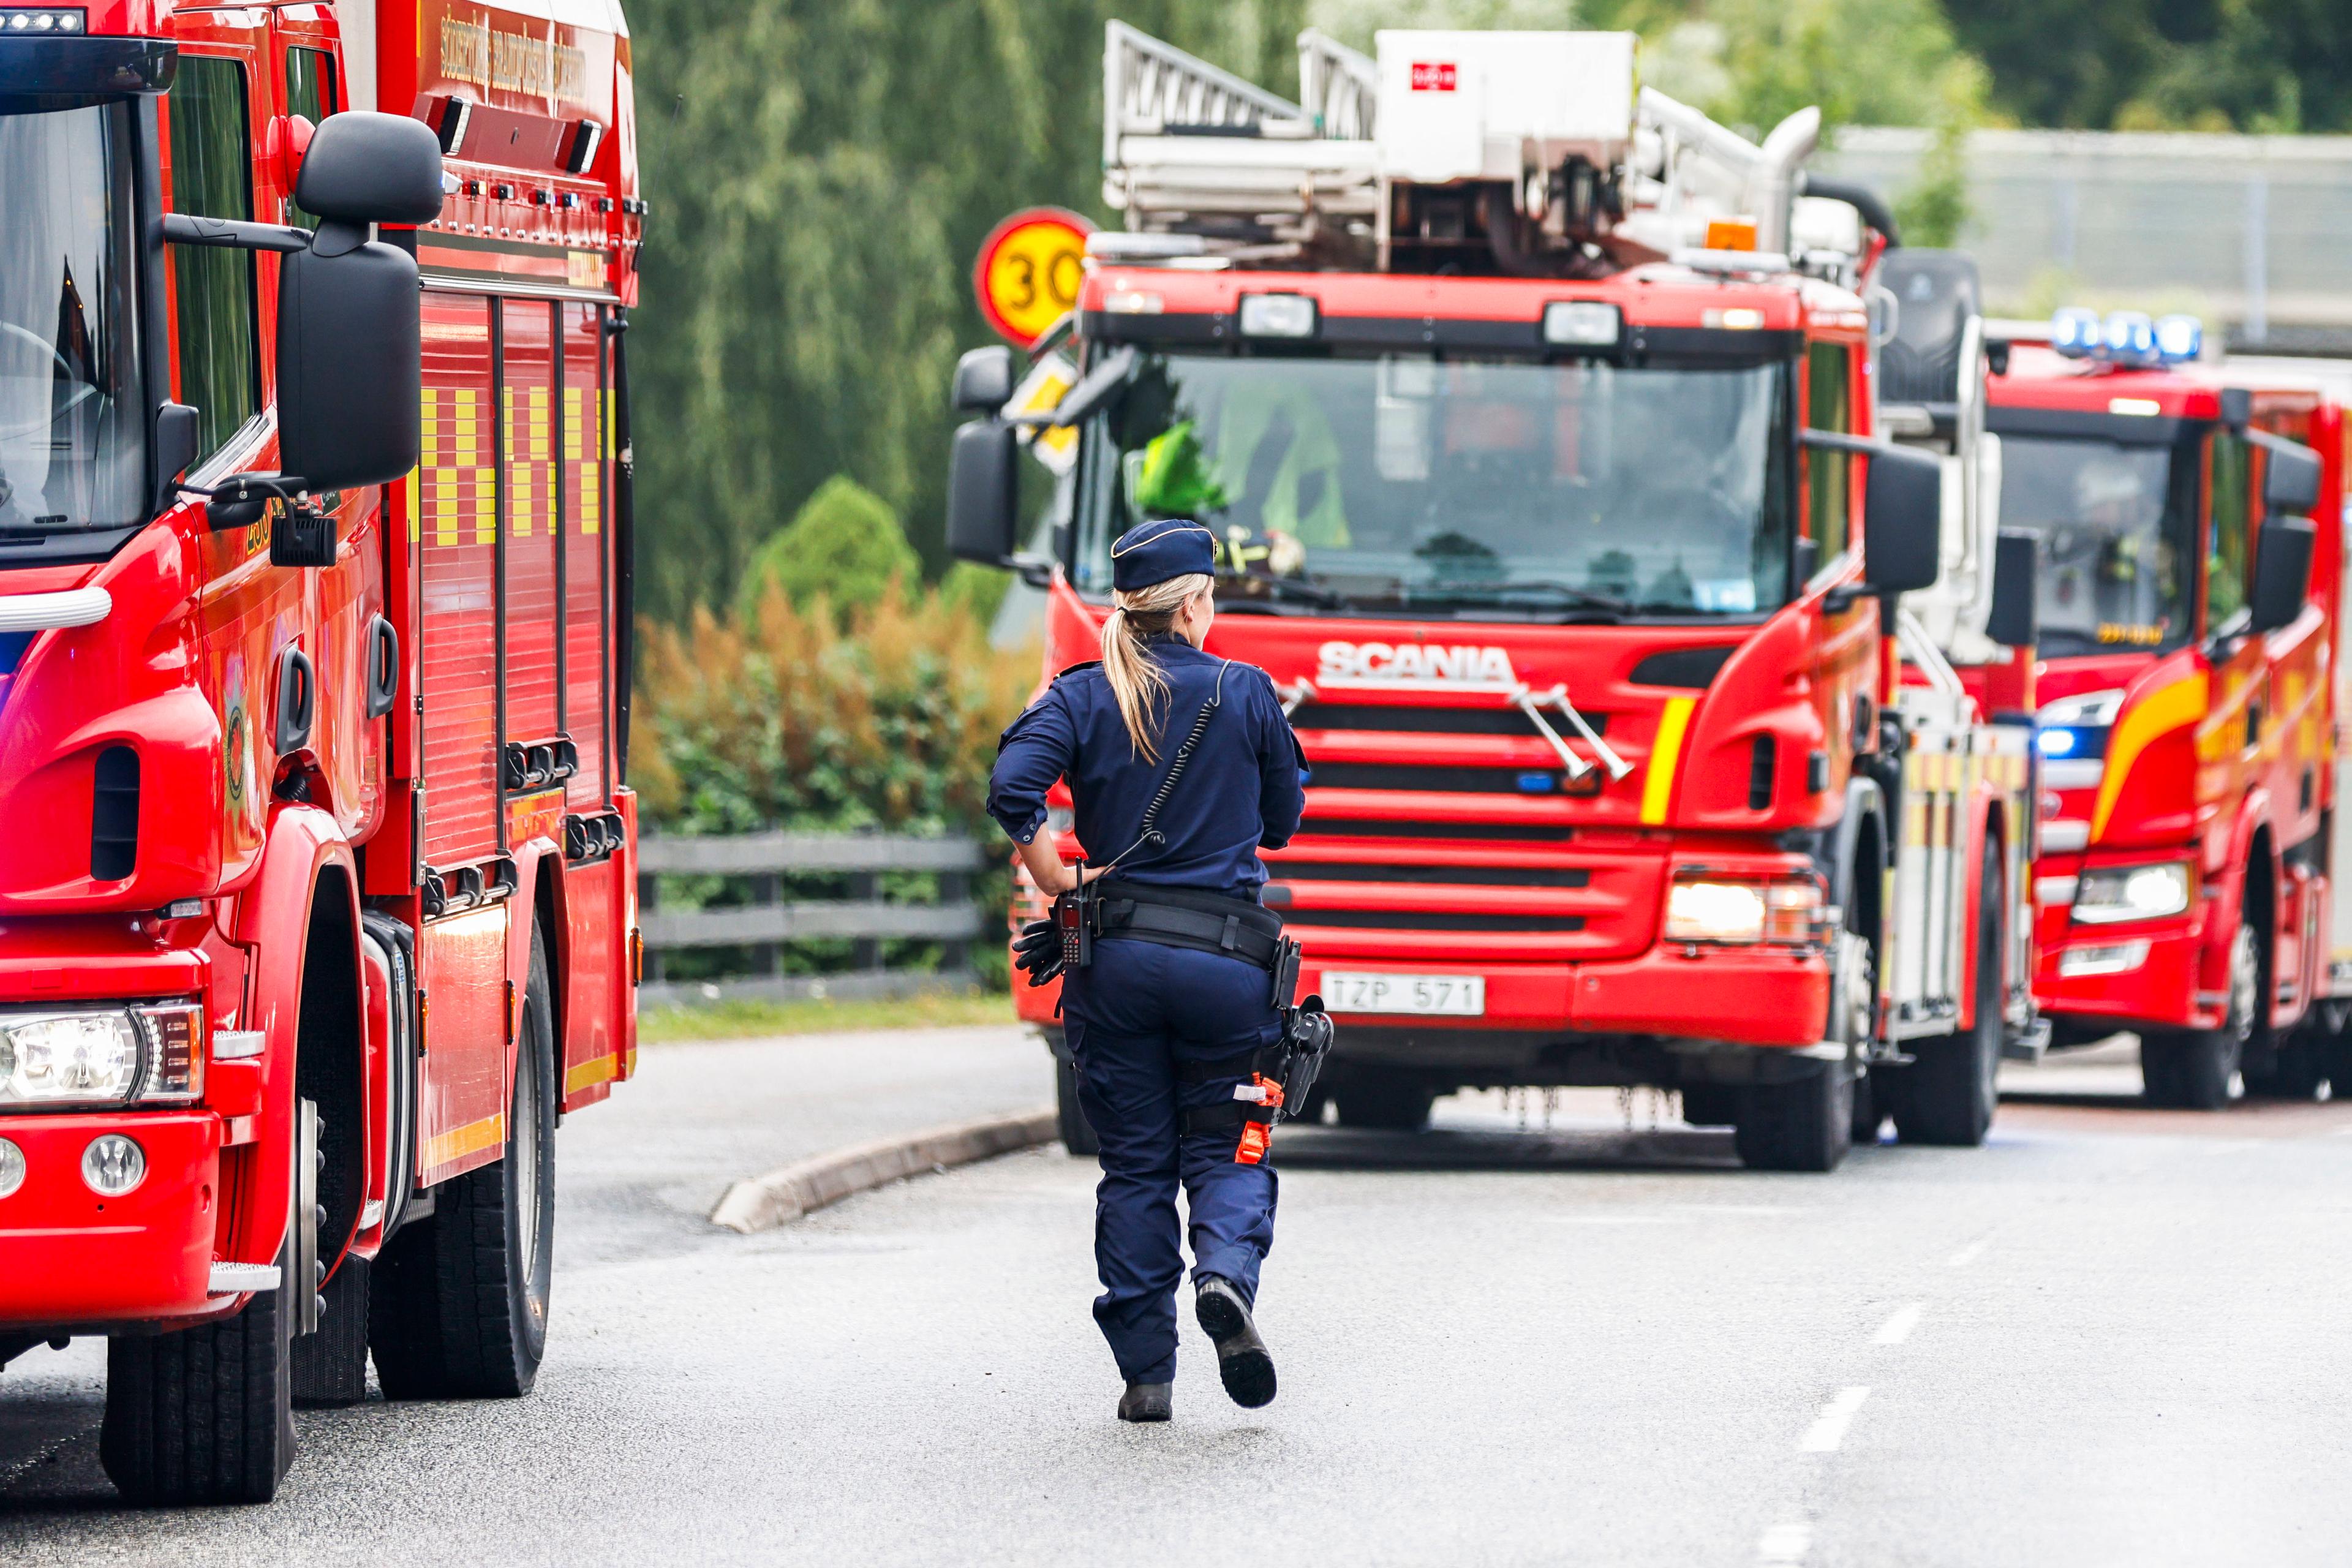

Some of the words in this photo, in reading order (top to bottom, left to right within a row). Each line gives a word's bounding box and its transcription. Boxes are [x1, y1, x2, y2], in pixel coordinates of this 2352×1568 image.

[1008, 250, 1085, 310] 30
[1317, 641, 1516, 682] SCANIA
[1333, 979, 1390, 1008] TZP
[1413, 981, 1473, 1008] 571
